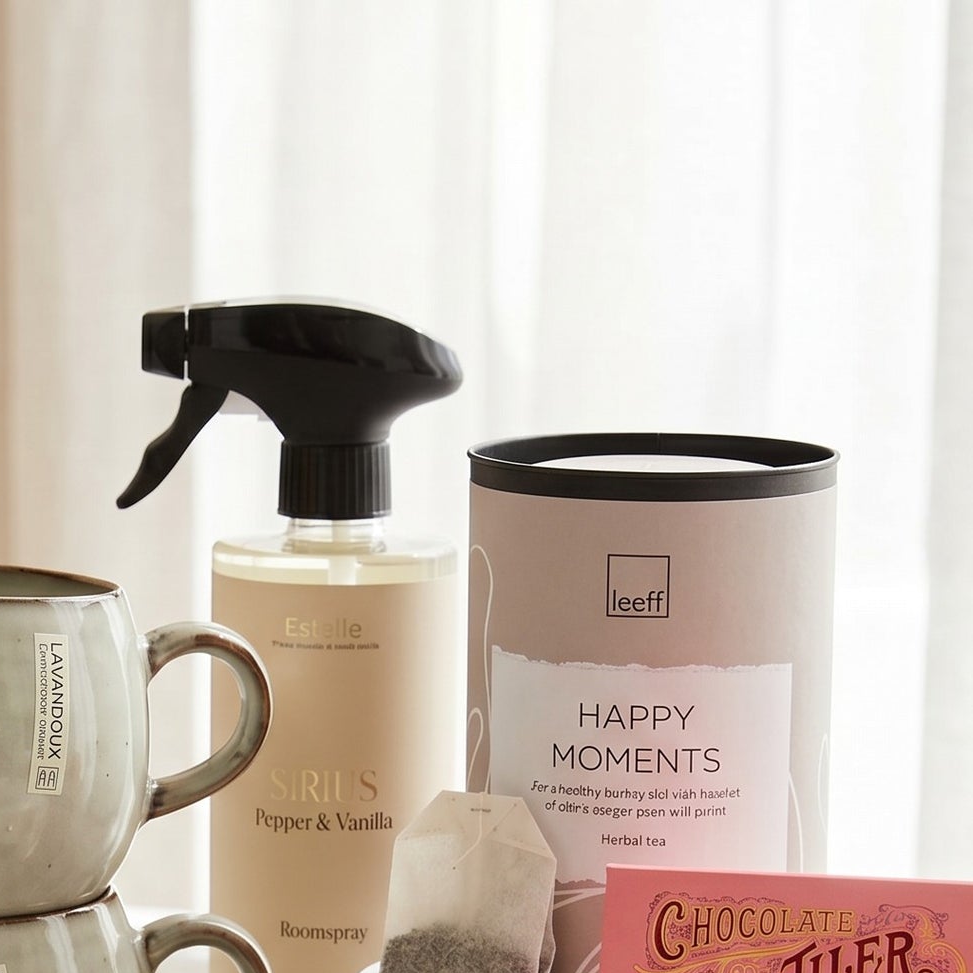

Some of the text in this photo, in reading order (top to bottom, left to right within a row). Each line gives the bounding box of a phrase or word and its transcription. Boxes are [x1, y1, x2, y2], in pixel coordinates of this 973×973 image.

[611, 589, 665, 613] leeff
[285, 617, 362, 639] Estelle
[48, 642, 64, 760] LAVANDOUX
[579, 702, 695, 731] HAPPY
[552, 743, 722, 774] MOMENTS
[270, 769, 378, 802] SIRIUS
[550, 786, 557, 794] a
[255, 807, 393, 834] Pepper & Vanilla
[544, 800, 557, 811] of
[670, 805, 691, 817] will
[601, 834, 666, 847] Herbal tea
[279, 920, 368, 945] Roomspray
[654, 900, 854, 961] CHOCOLATE
